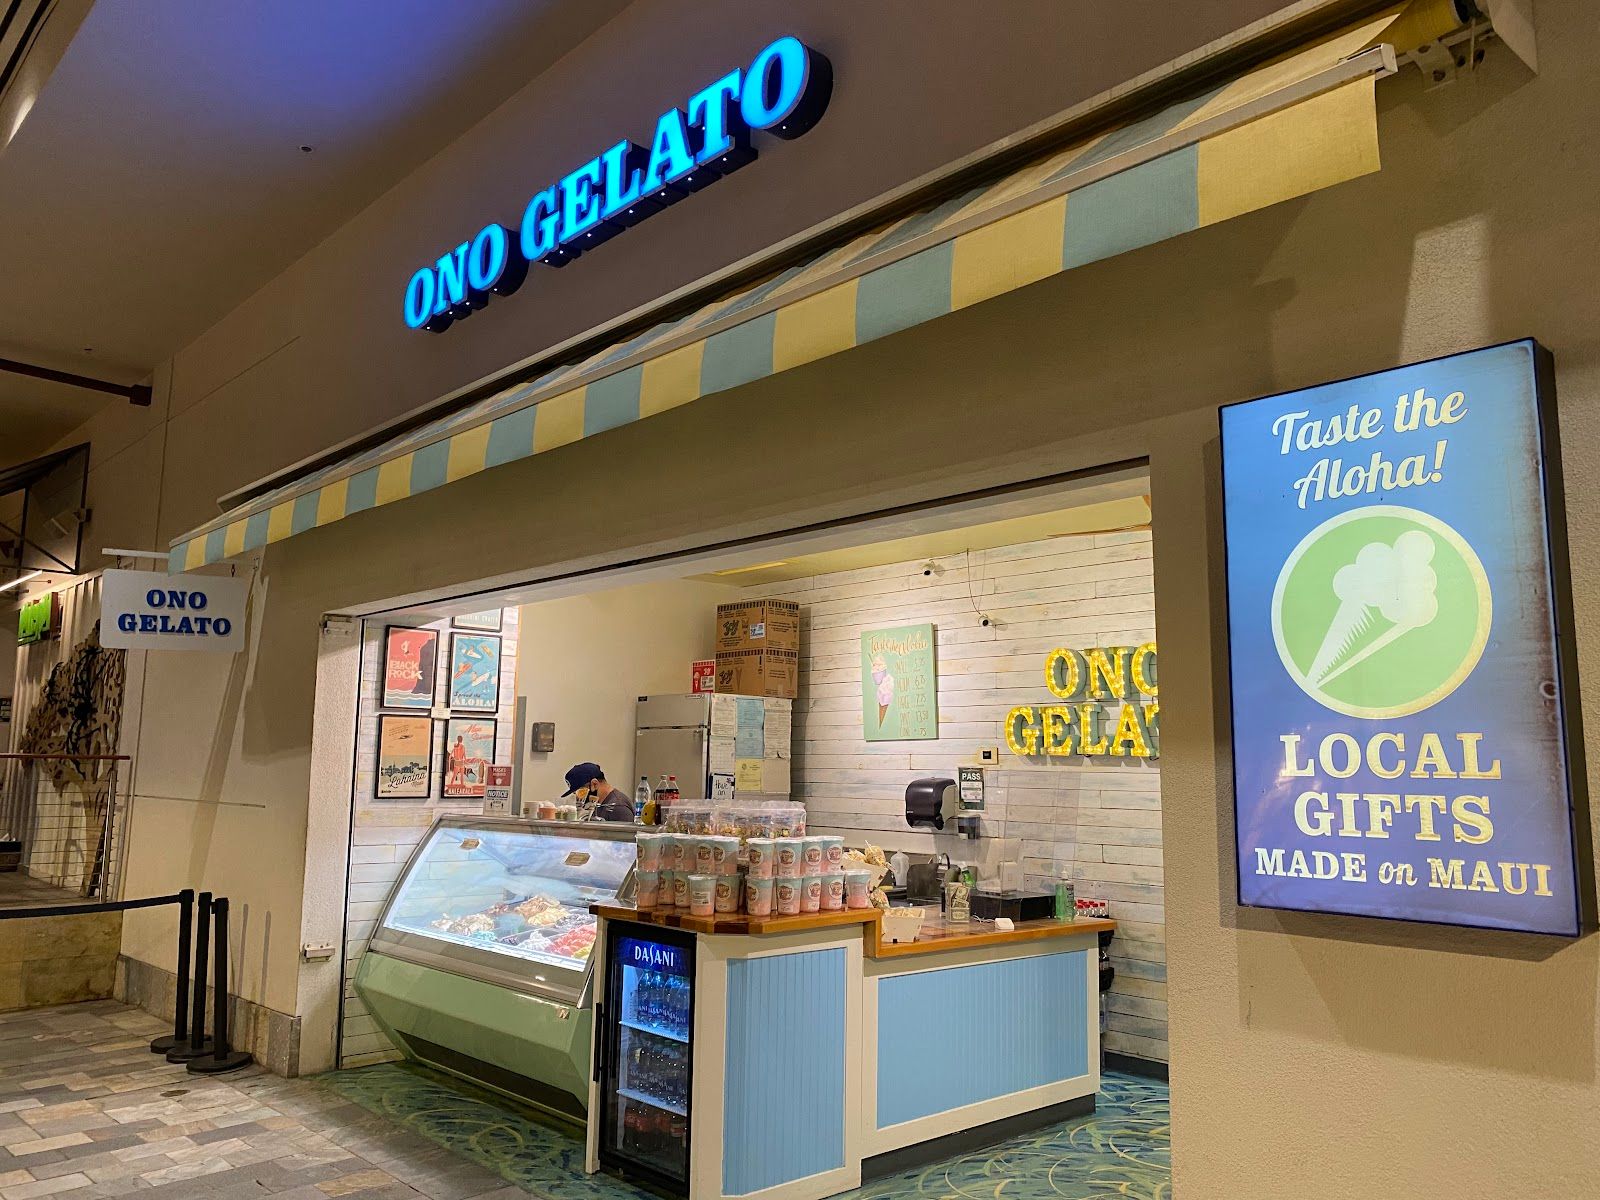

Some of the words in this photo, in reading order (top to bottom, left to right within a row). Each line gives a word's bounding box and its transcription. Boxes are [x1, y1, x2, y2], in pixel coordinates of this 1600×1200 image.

[404, 223, 508, 330] ONO
[520, 36, 810, 262] GELATO
[1272, 404, 1384, 455] Taste
[1393, 387, 1469, 433] the
[1293, 439, 1448, 509] Aloha!
[146, 589, 208, 610] ONO
[117, 613, 232, 636] GELATO
[388, 669, 423, 680] ROCK
[1004, 702, 1160, 757] GELA
[1279, 732, 1502, 780] LOCAL
[388, 773, 426, 789] Lahaina
[961, 772, 981, 780] PASS
[487, 790, 508, 798] NOTICE
[1294, 791, 1494, 844] GIFTS
[1254, 847, 1367, 883] MADE
[1377, 861, 1418, 886] on
[1427, 857, 1553, 897] MAUI
[634, 944, 674, 967] DASANI
